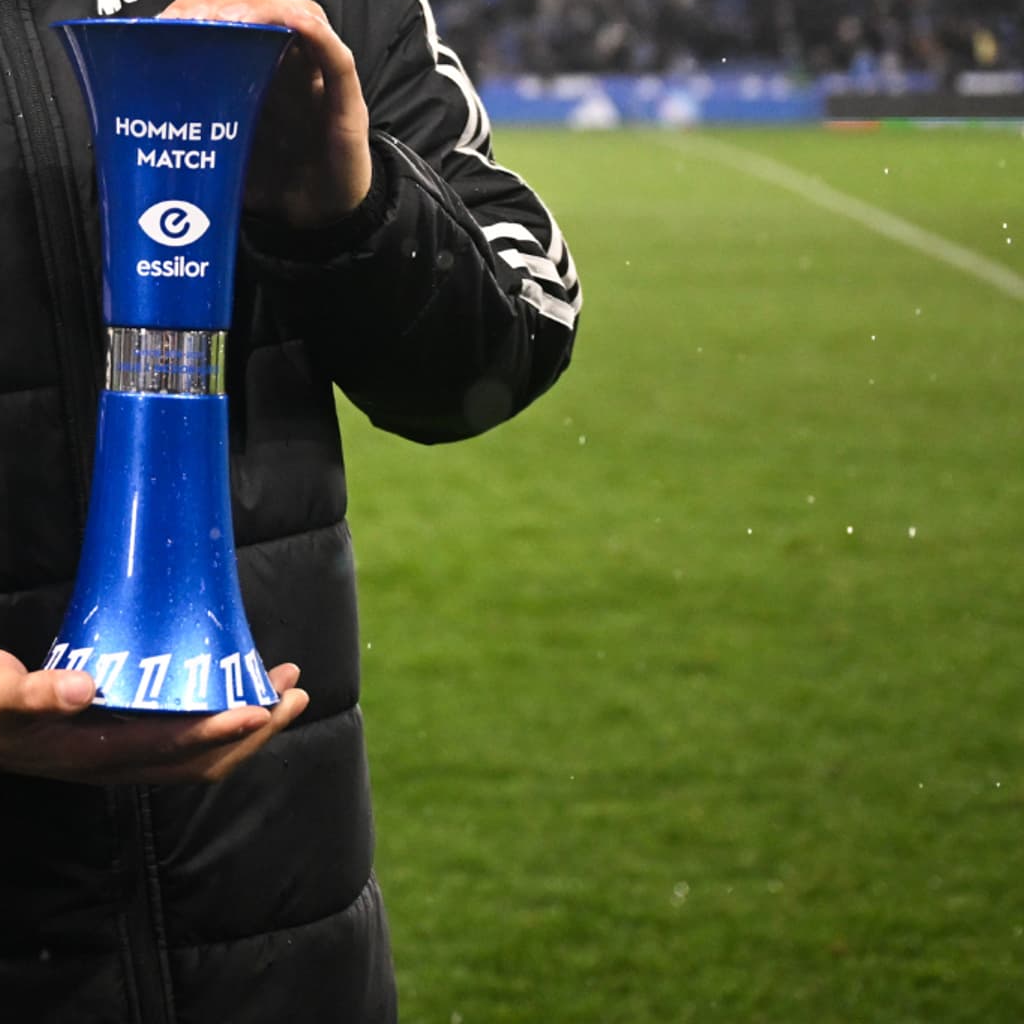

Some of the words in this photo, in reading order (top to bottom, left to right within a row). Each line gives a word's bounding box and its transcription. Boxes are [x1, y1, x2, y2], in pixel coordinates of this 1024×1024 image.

[115, 116, 202, 141] HOMME
[210, 121, 238, 141] DU
[137, 148, 216, 169] MATCH
[136, 255, 210, 278] essilor
